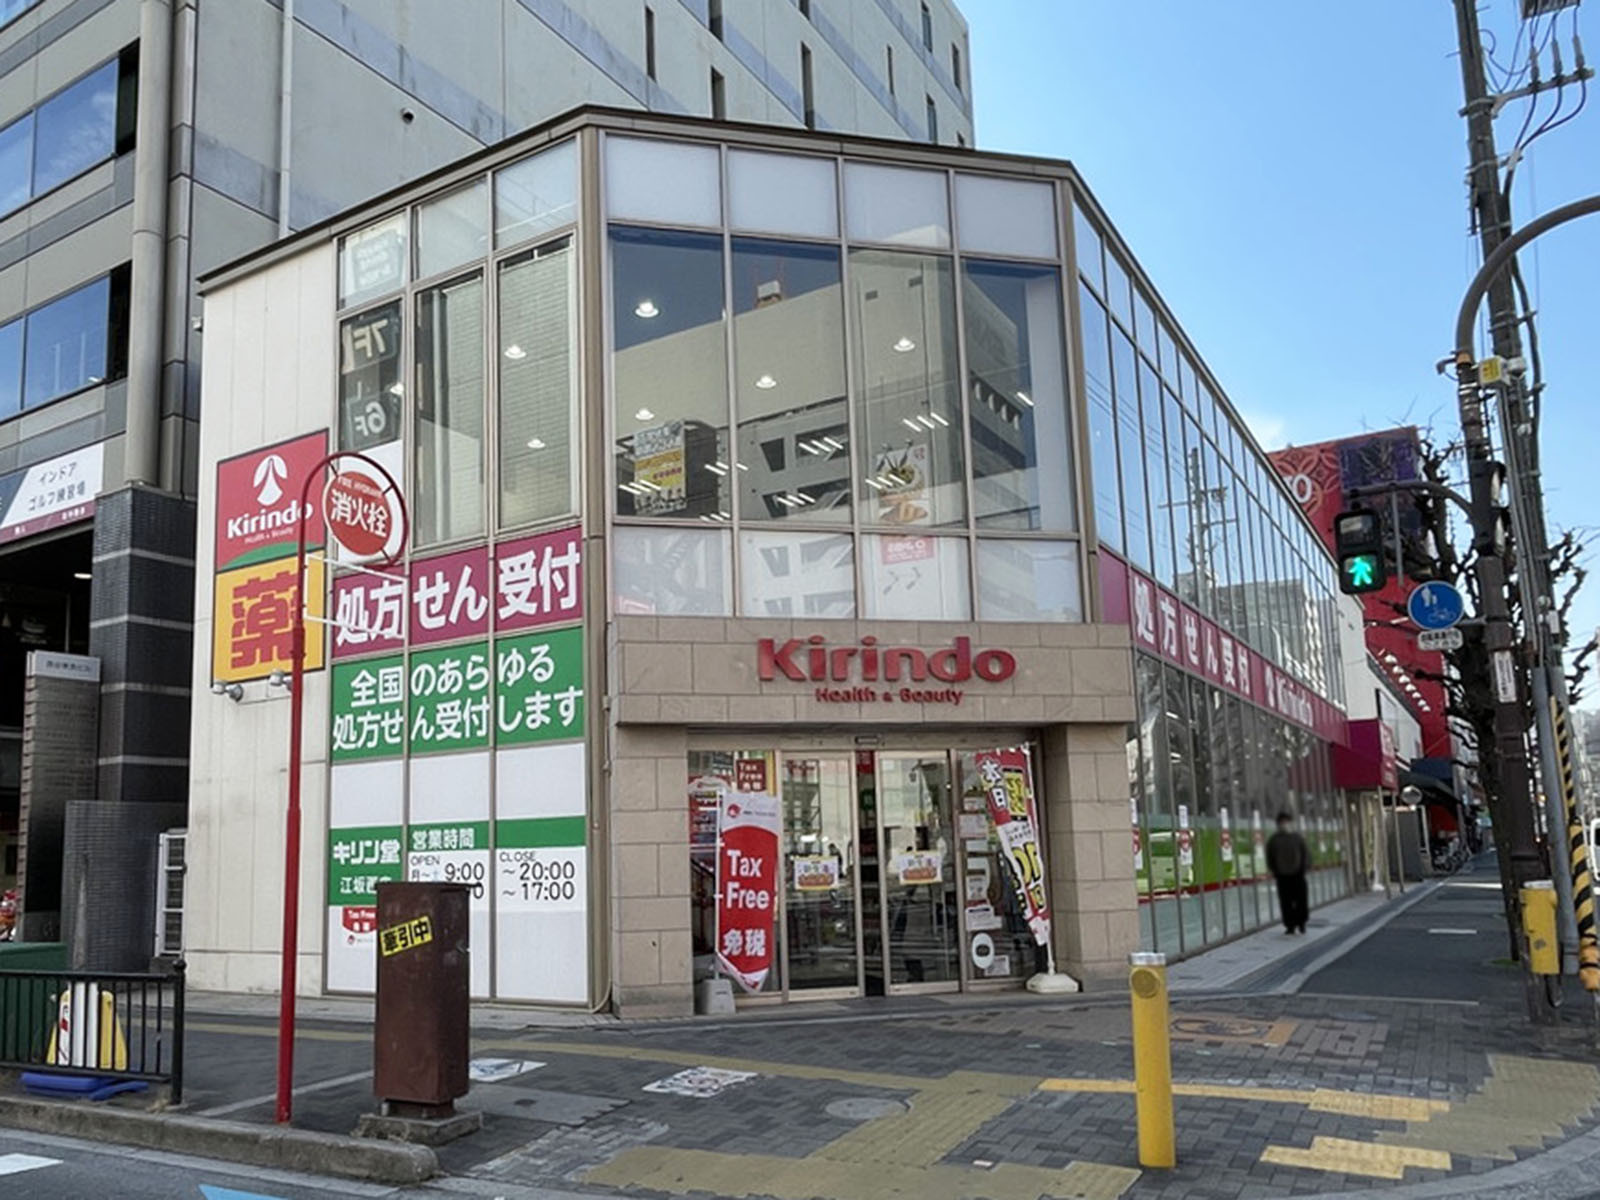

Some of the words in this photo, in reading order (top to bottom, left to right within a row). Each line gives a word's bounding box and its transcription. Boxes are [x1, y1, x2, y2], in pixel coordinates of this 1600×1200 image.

[39, 461, 78, 485] インドア
[28, 480, 85, 511] ゴルフ練習場
[227, 499, 313, 539] Kirindo
[331, 488, 388, 538] 消火栓
[336, 541, 580, 647] 処方せん受付
[231, 571, 303, 669] 薬
[1133, 576, 1250, 695] 処方せん受付
[757, 636, 1016, 682] Kirindo
[350, 643, 556, 708] 全国のあらゆる
[815, 687, 877, 703] Health
[900, 687, 964, 706] Beauty
[333, 686, 584, 752] 処方せん受付します
[333, 839, 401, 865] キリン堂
[412, 828, 475, 851] 営業時間
[410, 854, 441, 867] OPEN
[500, 851, 536, 863] CLOSE
[727, 849, 762, 877] Tax
[340, 876, 392, 895] 江坂西
[445, 862, 485, 882] 9:00
[726, 882, 769, 910] Free
[723, 929, 766, 957] 免税
